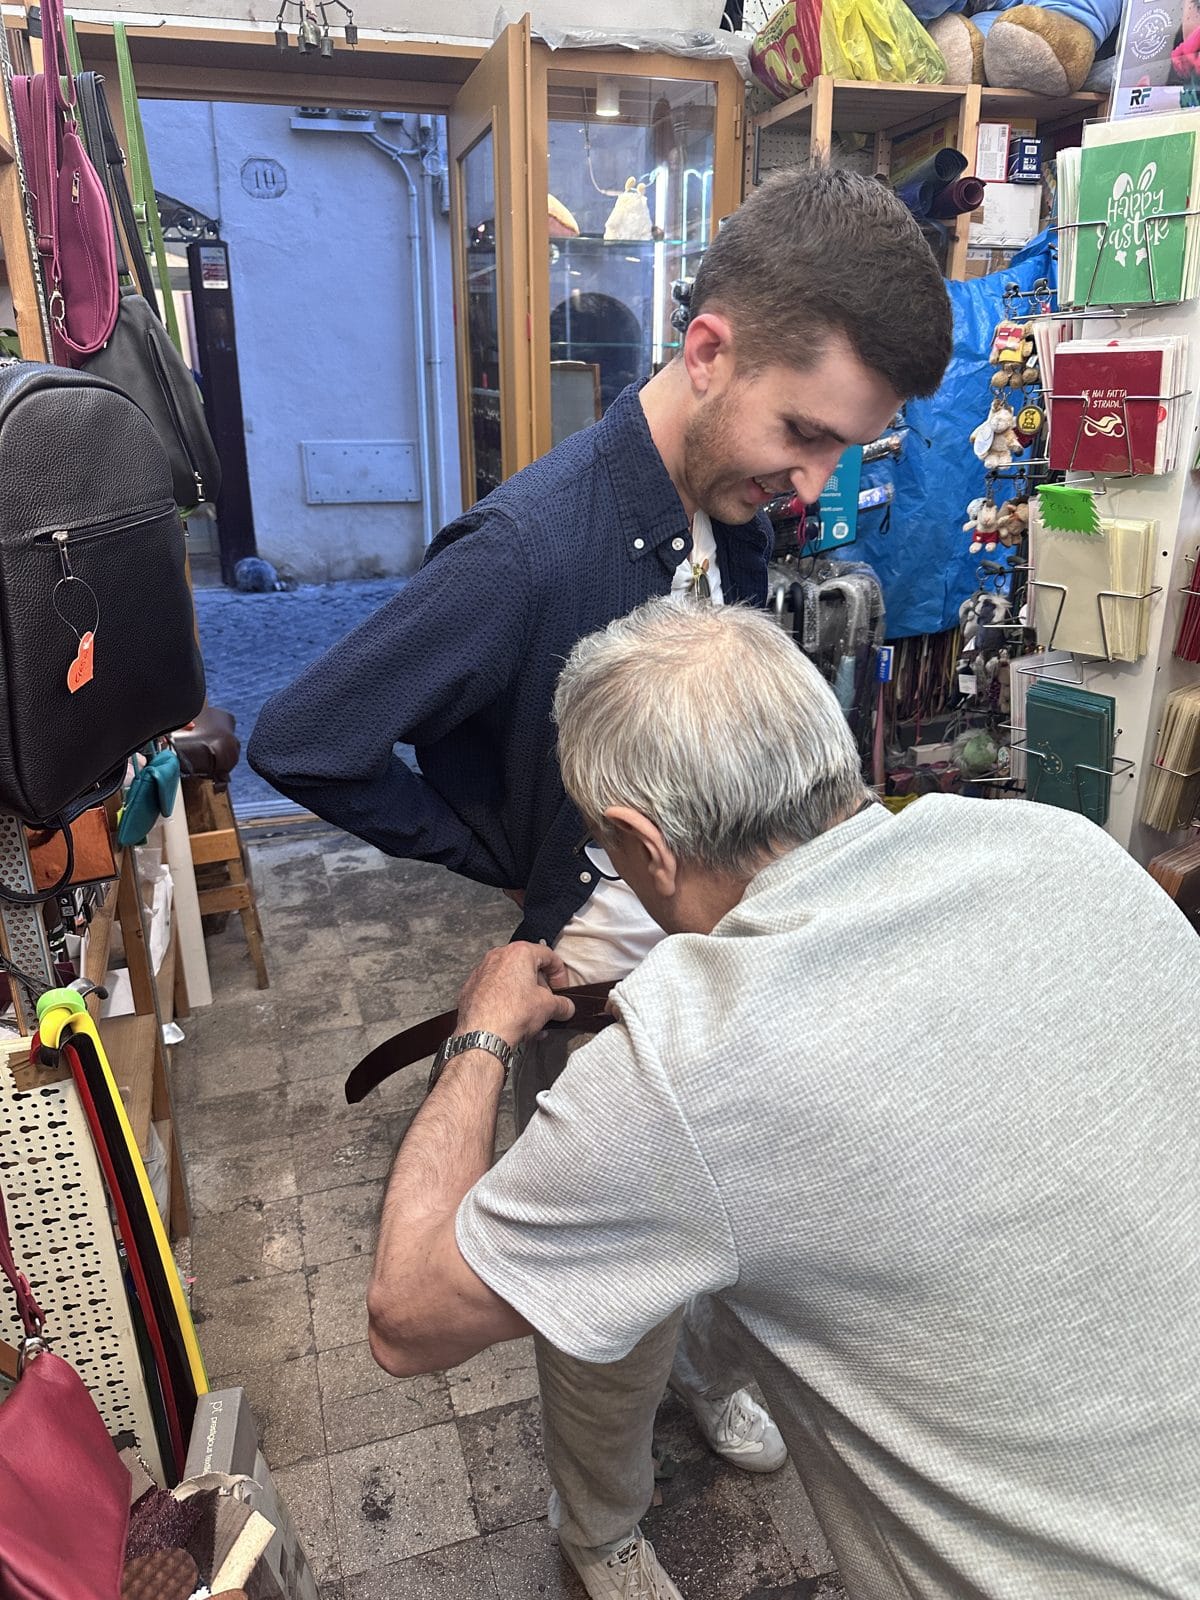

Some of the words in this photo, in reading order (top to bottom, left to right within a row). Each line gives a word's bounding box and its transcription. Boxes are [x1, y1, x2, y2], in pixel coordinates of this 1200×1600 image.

[1129, 87, 1152, 106] RF
[1107, 189, 1164, 222] Happy
[1092, 390, 1104, 398] HAI
[1106, 390, 1127, 398] FATTA
[209, 1400, 223, 1414] pt
